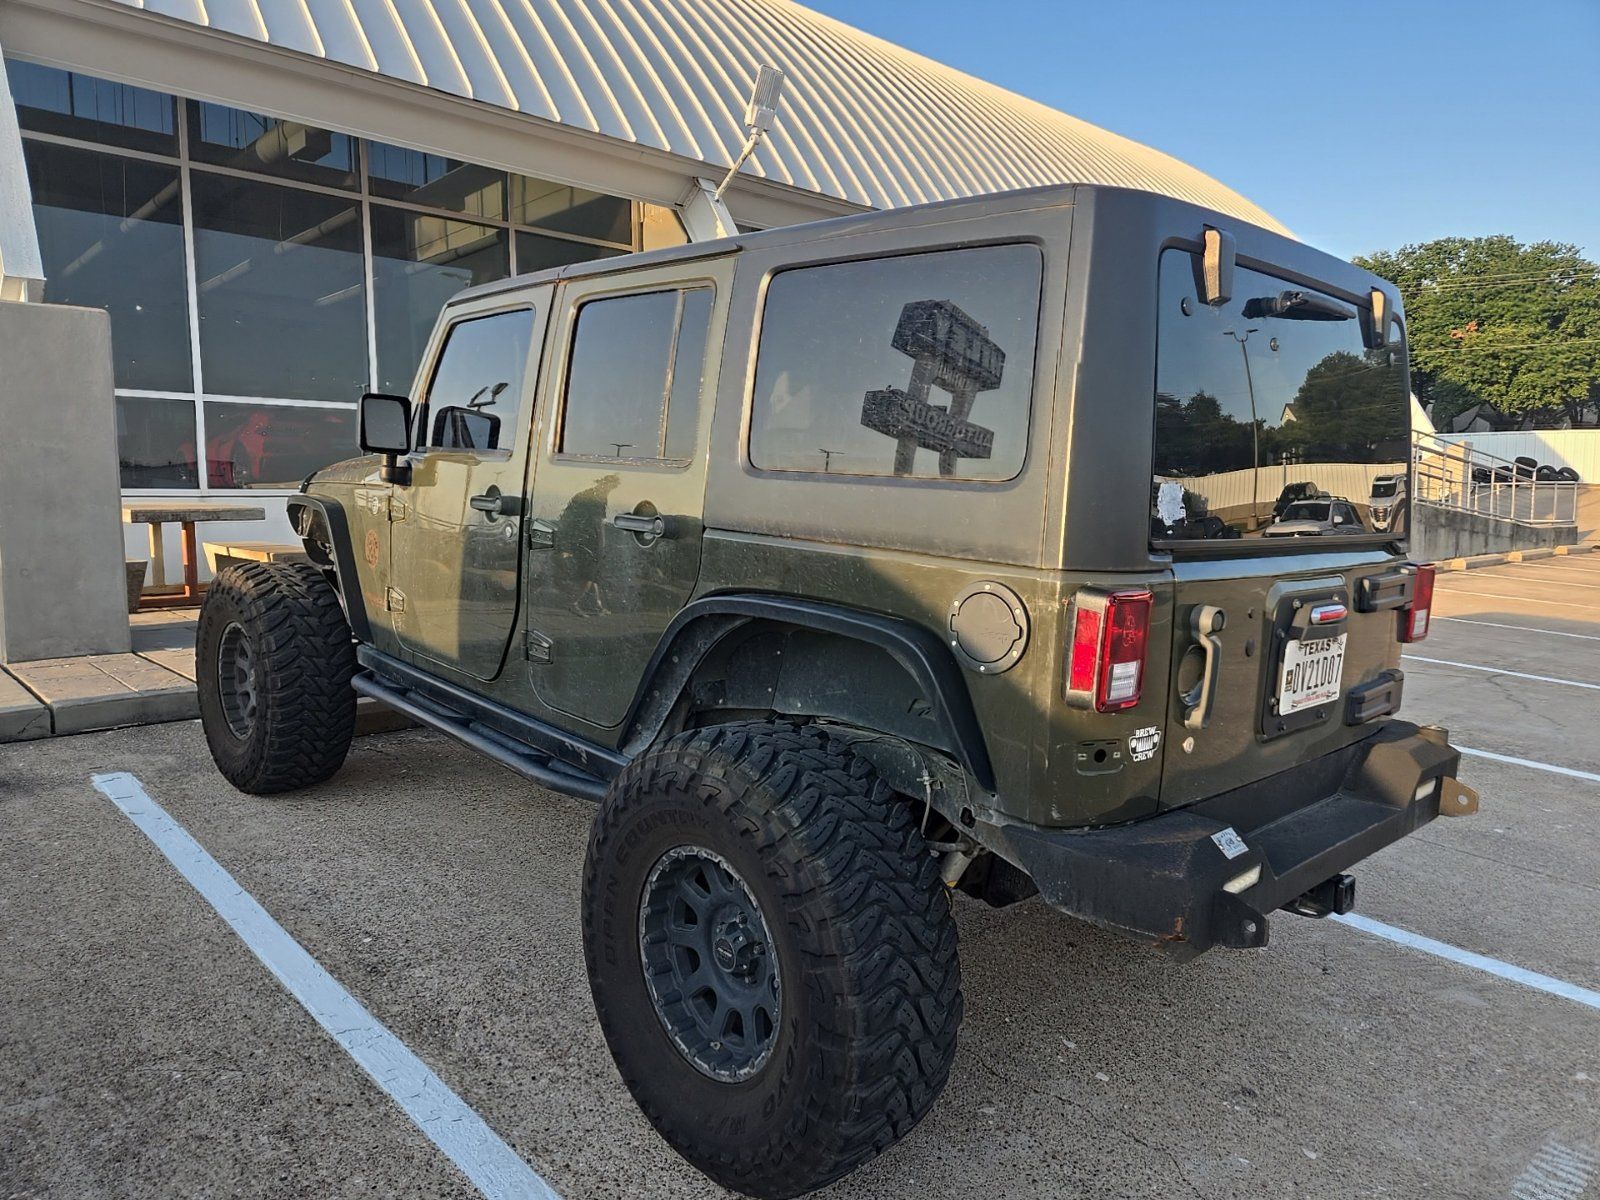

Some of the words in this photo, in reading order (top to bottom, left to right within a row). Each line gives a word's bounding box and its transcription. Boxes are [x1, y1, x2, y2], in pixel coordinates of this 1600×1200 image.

[1303, 639, 1331, 656] TEXAS
[1292, 653, 1342, 694] DV21D07
[1135, 726, 1157, 738] BREW
[1133, 750, 1153, 762] CREW
